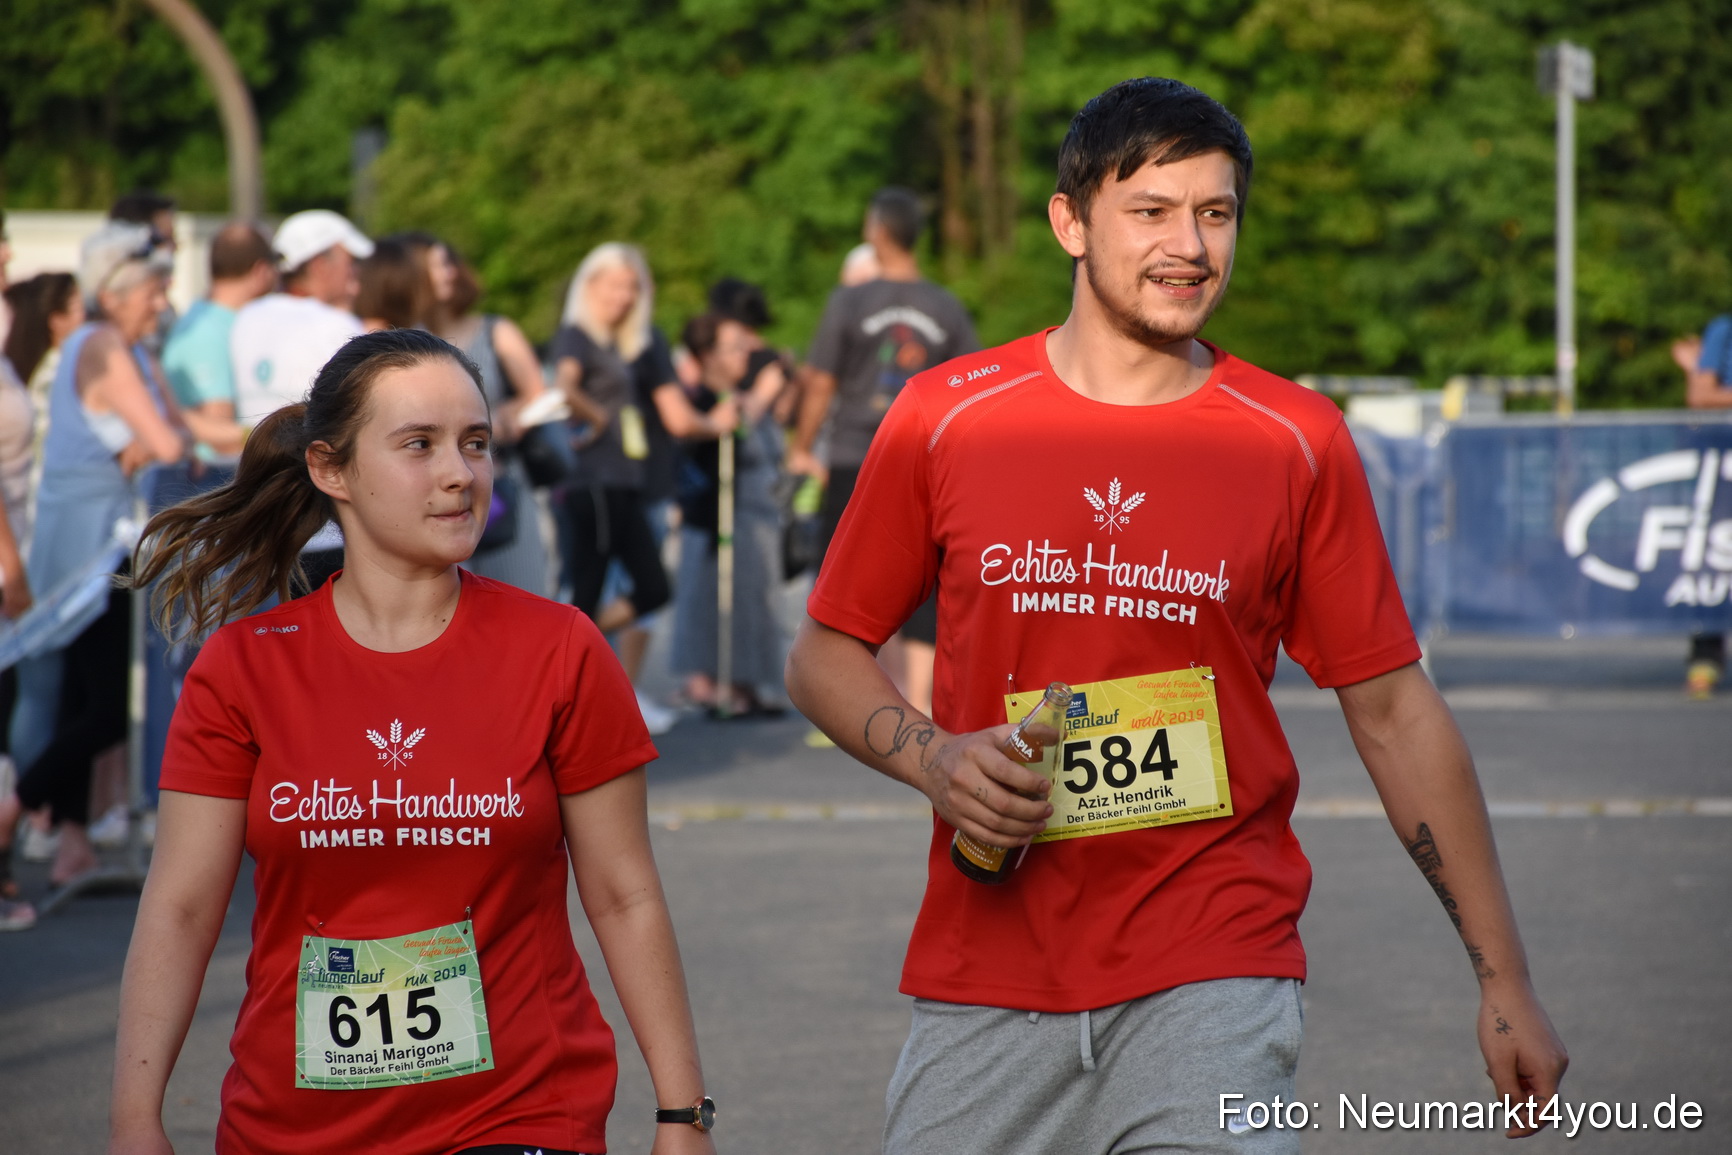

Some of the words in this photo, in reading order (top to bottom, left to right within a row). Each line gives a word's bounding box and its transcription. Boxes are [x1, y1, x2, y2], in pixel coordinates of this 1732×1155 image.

[966, 364, 1001, 381] JAKO
[1093, 514, 1105, 523] 18
[1119, 515, 1130, 524] 95
[981, 538, 1080, 586] Echtes
[1082, 542, 1230, 603] Handwerk
[1664, 572, 1732, 607] AU
[1012, 592, 1095, 614] IMMER
[1105, 595, 1197, 625] FRISCH
[270, 625, 299, 633] JAKO
[1131, 709, 1165, 729] walk
[1169, 708, 1205, 725] 2019
[377, 752, 388, 760] 18
[403, 751, 413, 760] 95
[1063, 728, 1178, 794] 584
[270, 778, 366, 822] Echtes
[369, 777, 525, 819] Handwerk
[1077, 796, 1109, 810] Aziz
[1113, 785, 1173, 805] Hendrik
[1067, 814, 1085, 824] Der
[1088, 809, 1125, 822] Bäcker
[1127, 805, 1152, 817] Feihl
[1154, 798, 1187, 812] GmbH
[300, 828, 385, 848] IMMER
[397, 827, 490, 846] FRISCH
[318, 968, 386, 984] firmenlauf
[405, 973, 429, 987] run
[434, 964, 467, 982] 2019
[329, 986, 441, 1048] 615
[325, 1050, 378, 1069] Sinanaj
[383, 1041, 455, 1060] Marigona
[330, 1067, 347, 1076] Der
[350, 1065, 385, 1076] Bäcker
[388, 1061, 414, 1073] Feihl
[417, 1055, 449, 1068] GmbH
